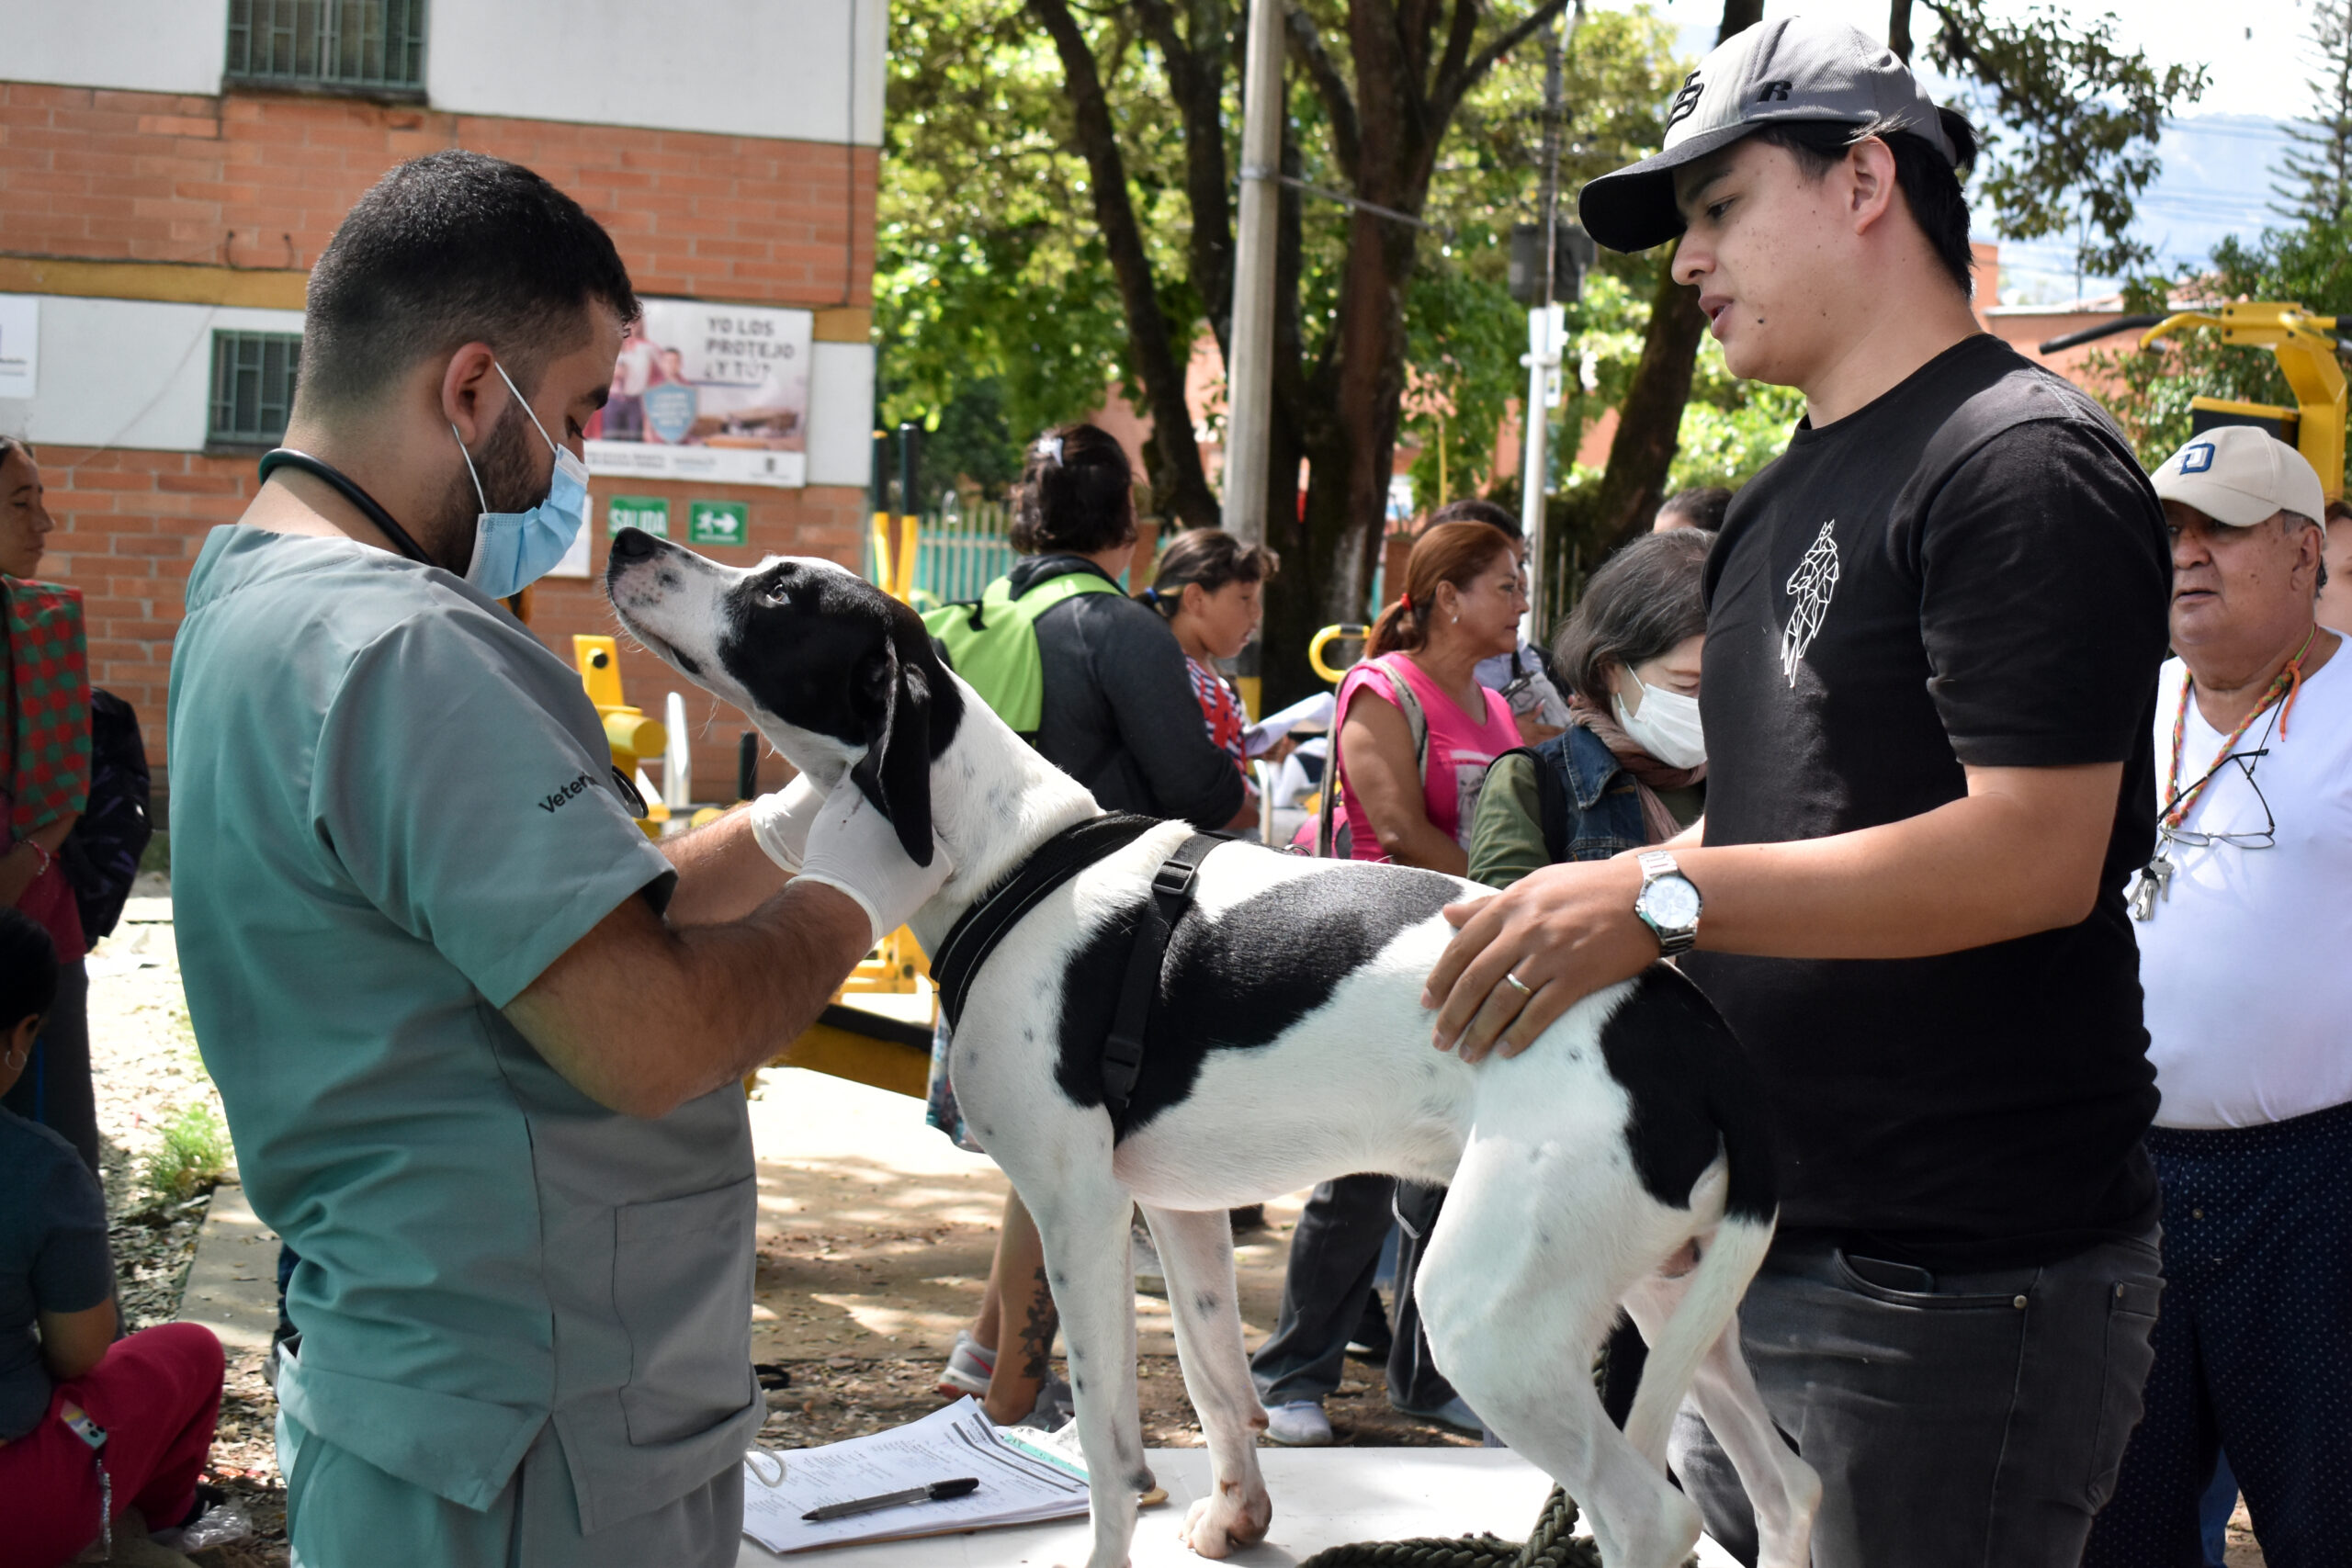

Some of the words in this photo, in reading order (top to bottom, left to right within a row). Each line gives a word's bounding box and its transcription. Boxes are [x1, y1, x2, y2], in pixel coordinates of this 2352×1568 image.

[1757, 80, 1792, 102] R
[708, 319, 733, 335] YO
[737, 319, 775, 337] LOS
[706, 339, 795, 359] PROTEJO
[609, 507, 667, 533] SALIDA
